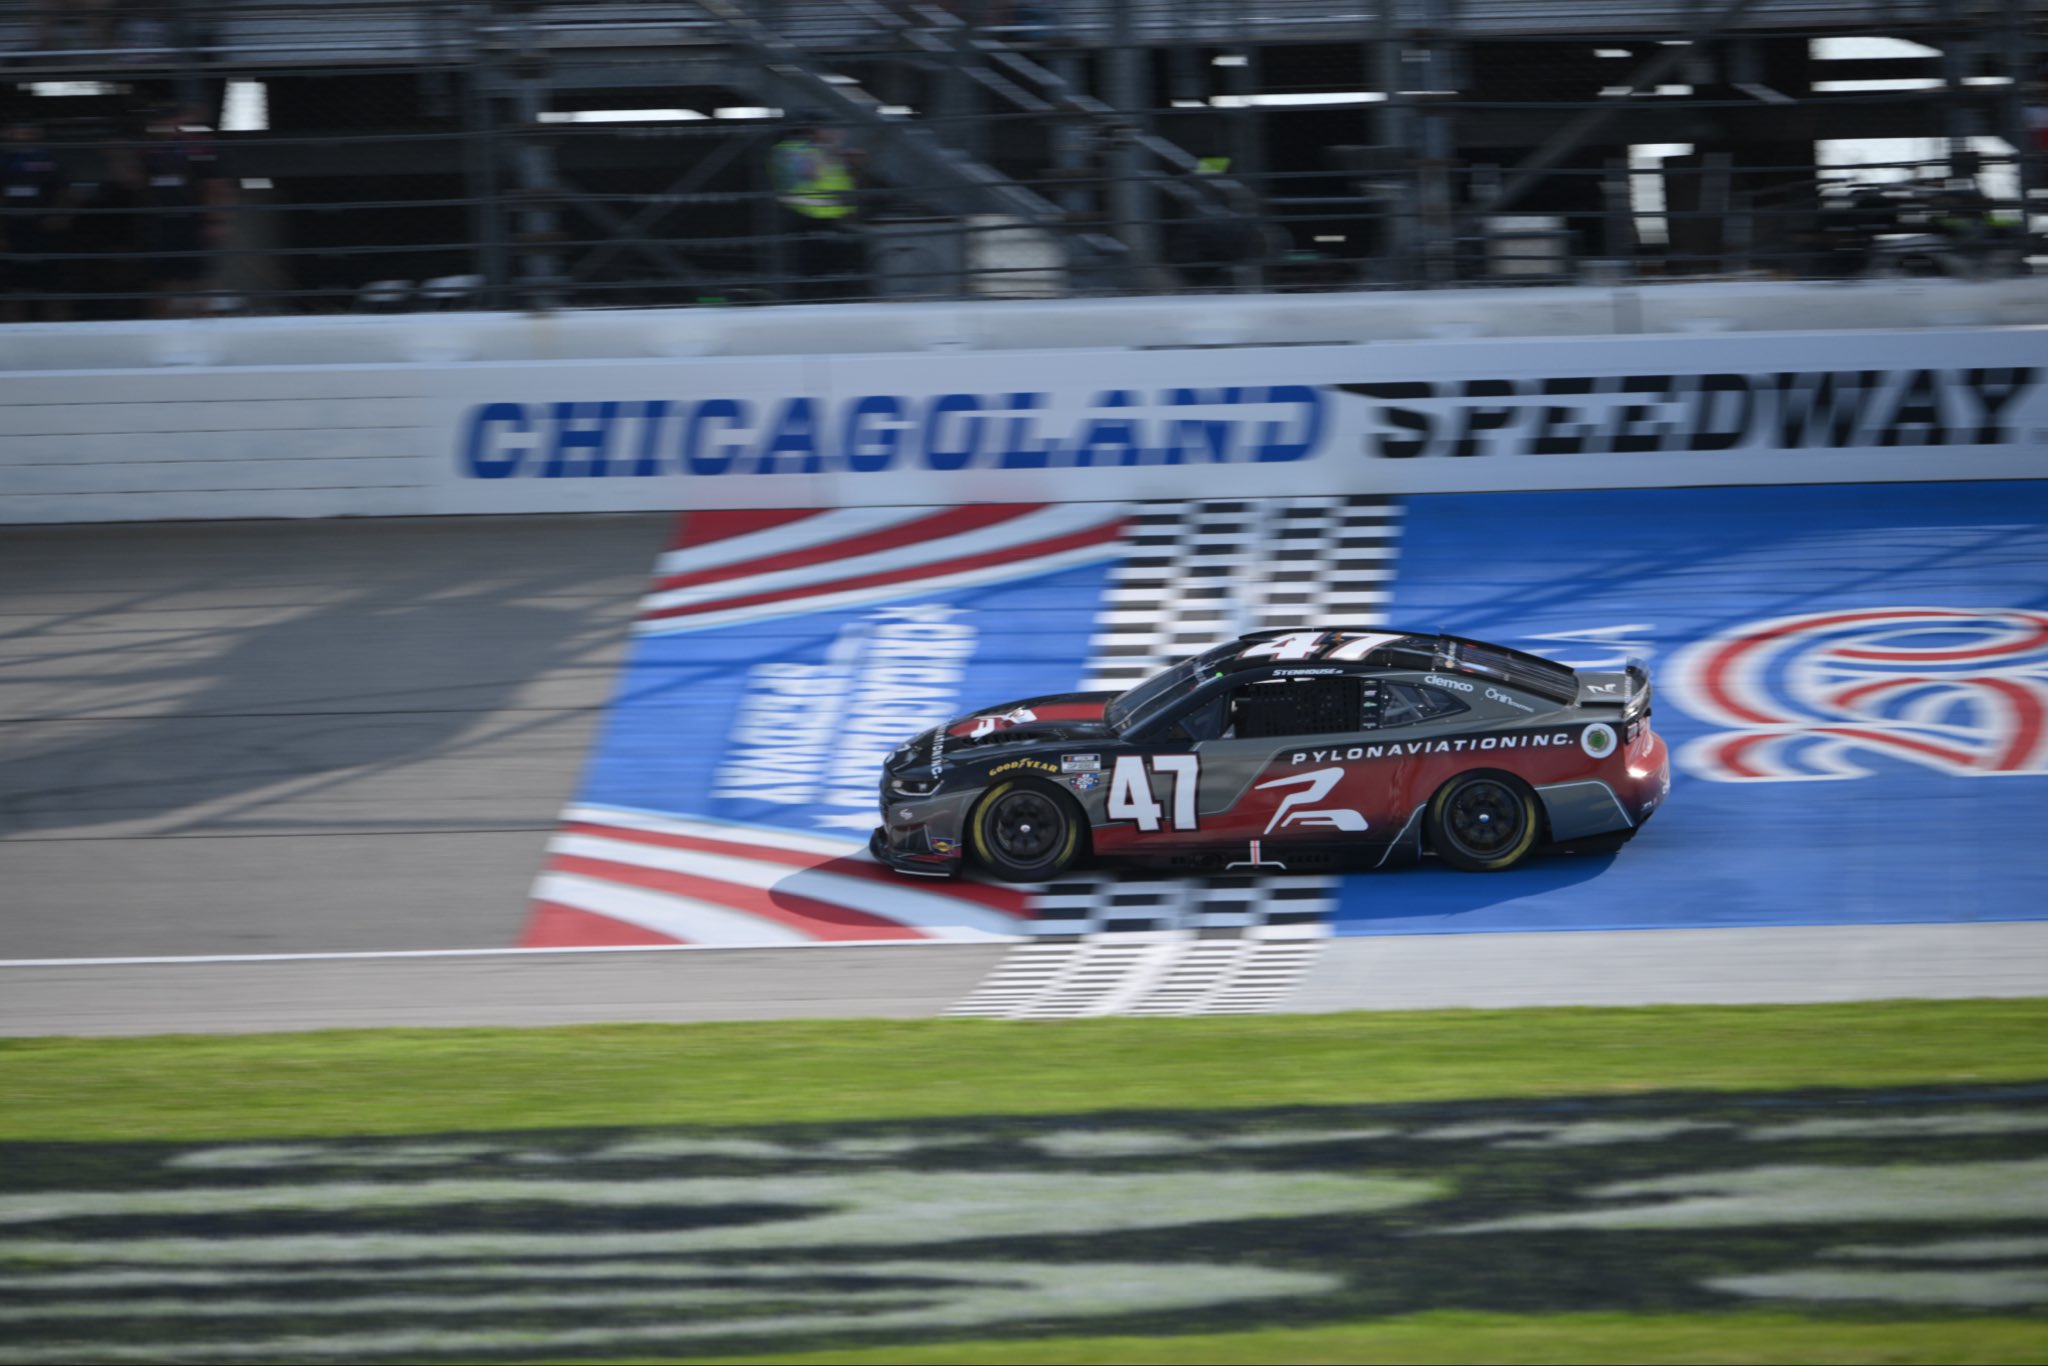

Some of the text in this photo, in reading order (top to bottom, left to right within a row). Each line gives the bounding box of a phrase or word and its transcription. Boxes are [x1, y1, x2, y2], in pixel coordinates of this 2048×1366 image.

[462, 366, 2044, 480] CHICAGOLAND SPEEDWAY
[1237, 631, 1409, 661] 47
[710, 662, 852, 804] SPEEDWAY
[989, 757, 1059, 776] GOODYEAR
[1105, 754, 1200, 832] 47
